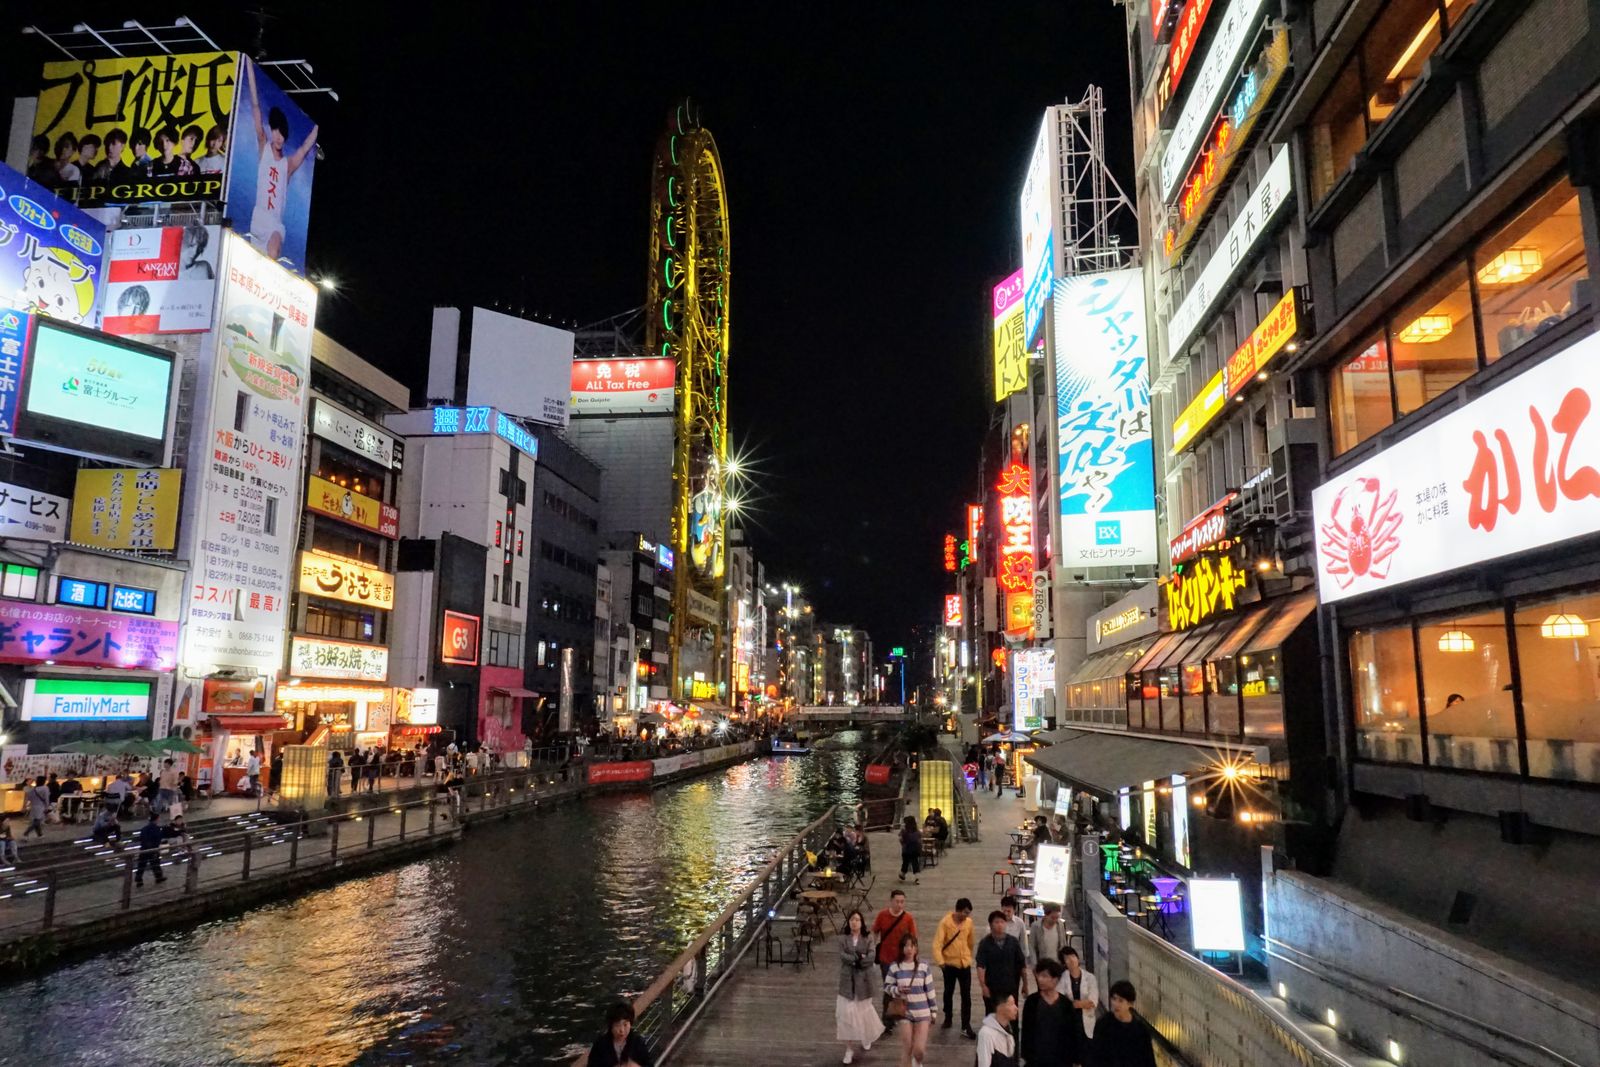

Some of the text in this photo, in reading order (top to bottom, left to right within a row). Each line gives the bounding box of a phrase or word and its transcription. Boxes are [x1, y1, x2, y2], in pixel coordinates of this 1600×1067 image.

[112, 180, 221, 199] GROUP
[267, 165, 281, 210] ホスト
[1229, 181, 1274, 269] 白木屋
[137, 260, 177, 274] KANZAKI
[152, 267, 176, 280] RUKA
[998, 317, 1013, 395] バイト
[1011, 310, 1026, 388] 高収入
[596, 363, 641, 379] 免税
[586, 380, 650, 390] ALL Tax Free
[1462, 387, 1600, 532] かに
[1098, 526, 1119, 539] BX
[316, 563, 373, 600] うなぎ
[1166, 555, 1246, 631] びっくりドンキー
[71, 583, 144, 609] 酒 たばこ
[194, 584, 235, 606] コスパ
[452, 627, 469, 651] G3
[314, 644, 363, 671] お好み焼
[54, 697, 130, 716] FamilyMart
